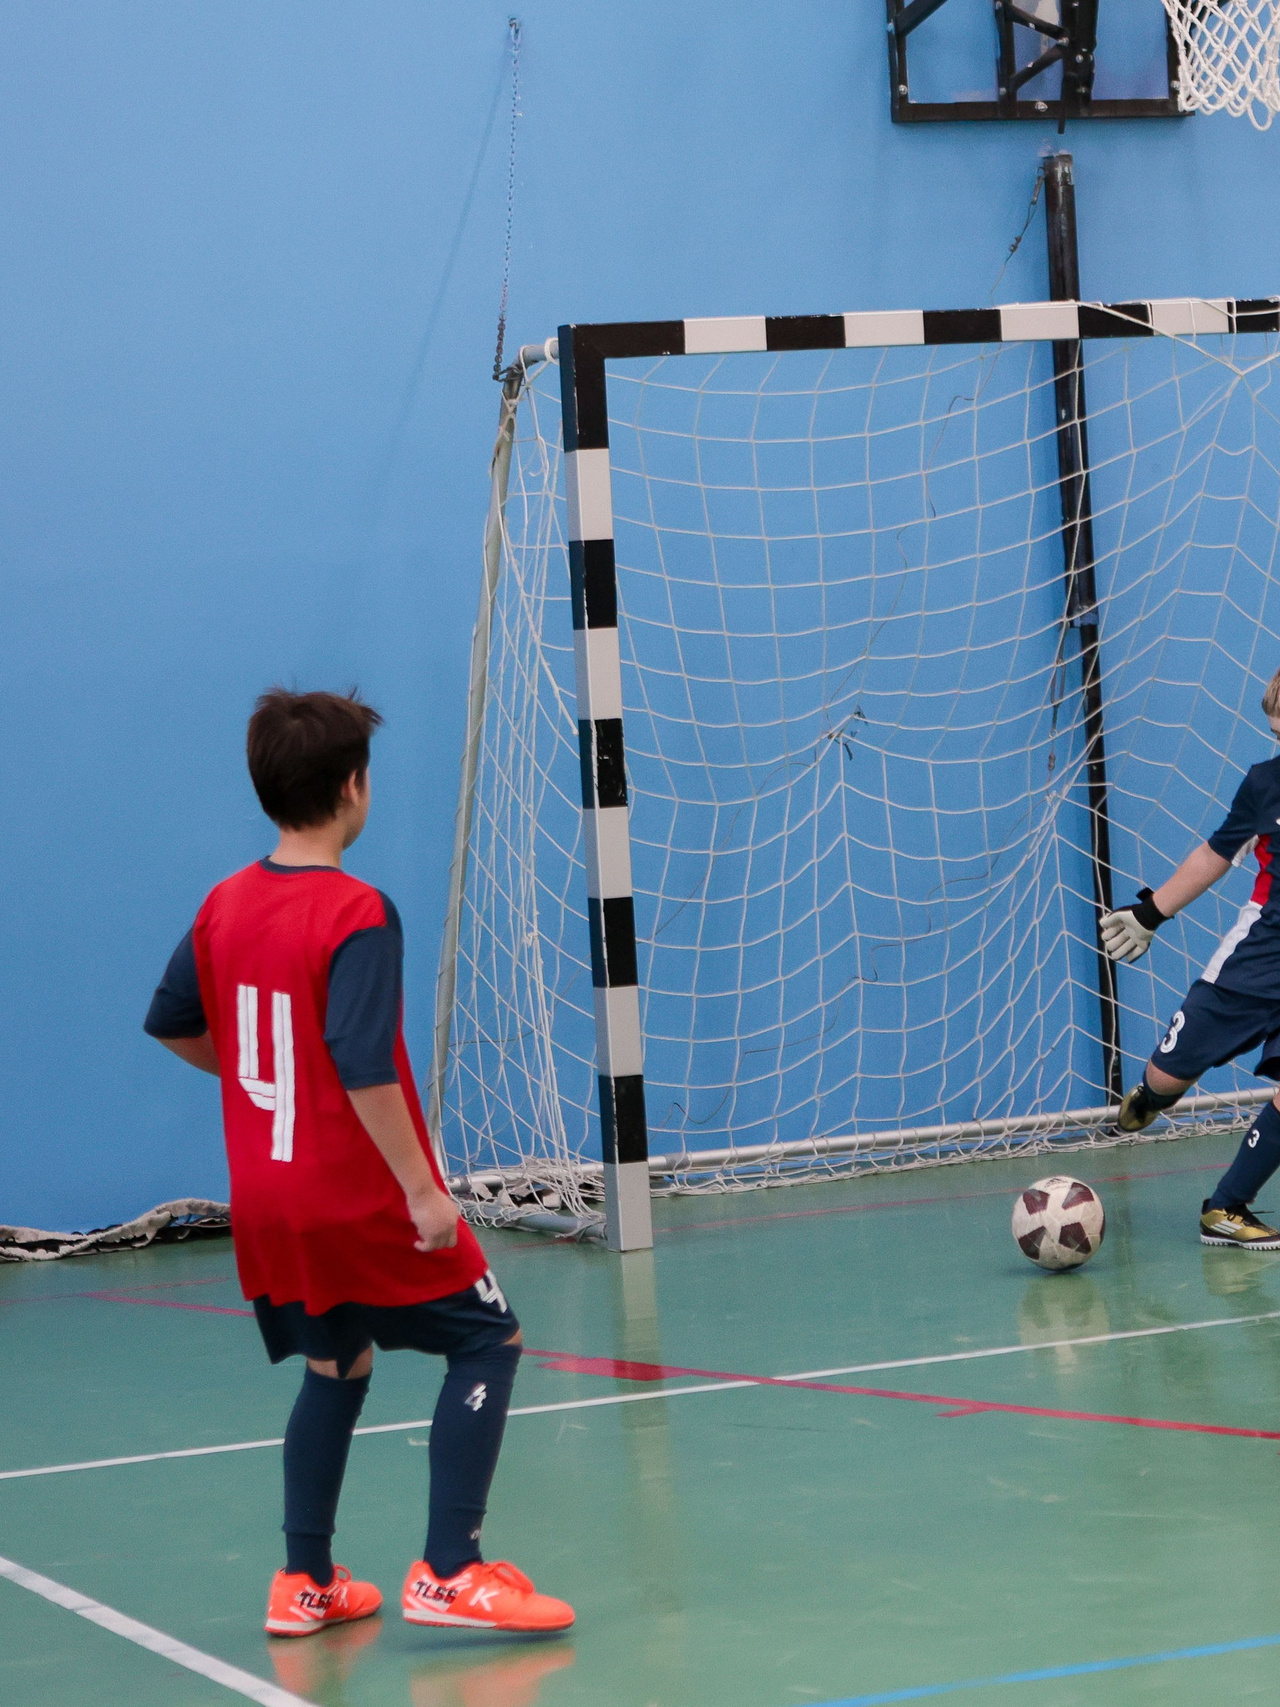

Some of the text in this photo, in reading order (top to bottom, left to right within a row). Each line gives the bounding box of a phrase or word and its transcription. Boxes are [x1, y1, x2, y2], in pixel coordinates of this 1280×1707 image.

[1159, 1010, 1186, 1054] 3
[237, 983, 296, 1163] 4
[1247, 1128, 1260, 1149] 3
[474, 1268, 508, 1314] 4
[464, 1382, 487, 1412] 4
[468, 1586, 500, 1612] K
